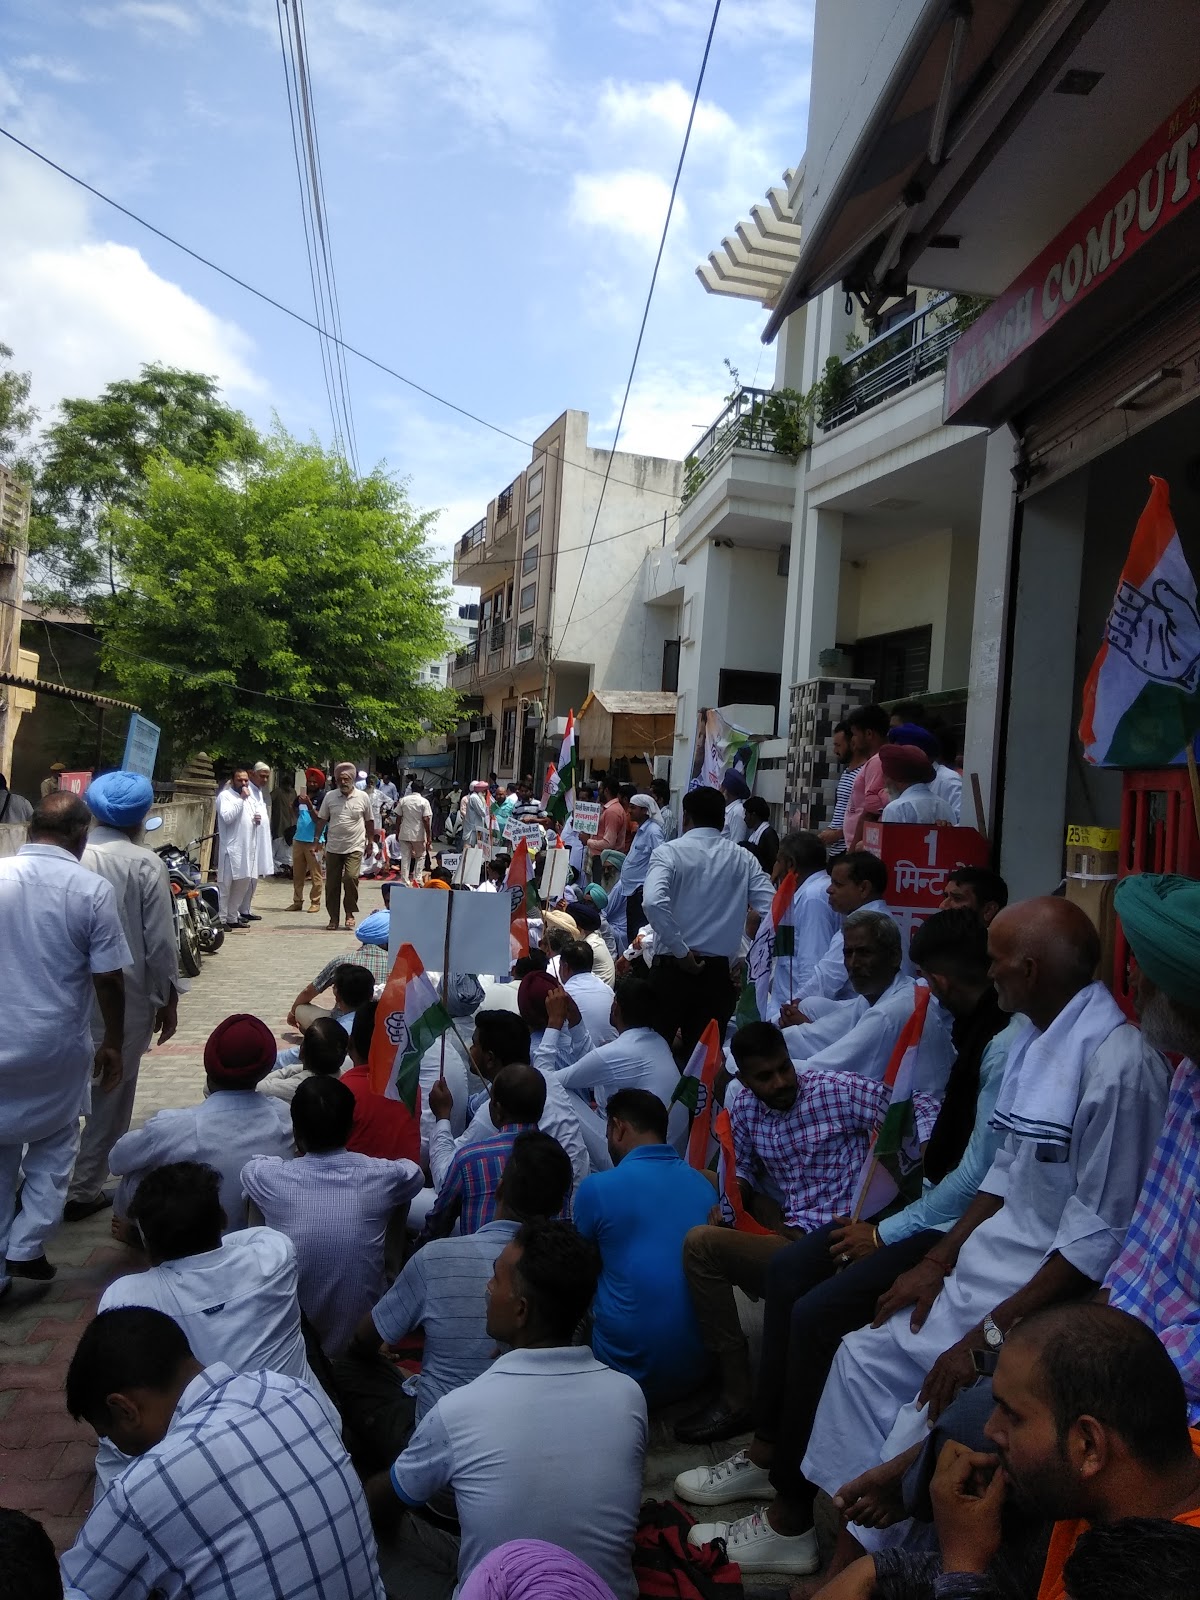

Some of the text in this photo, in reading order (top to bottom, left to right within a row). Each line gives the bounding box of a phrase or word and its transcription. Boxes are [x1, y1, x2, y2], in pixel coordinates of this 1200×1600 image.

[955, 122, 1200, 397] VANSH COMPUT
[71, 779, 81, 794] NO
[1069, 828, 1081, 842] 25
[924, 830, 939, 867] 1
[444, 858, 457, 866] गलत
[894, 859, 949, 896] मिन्ट
